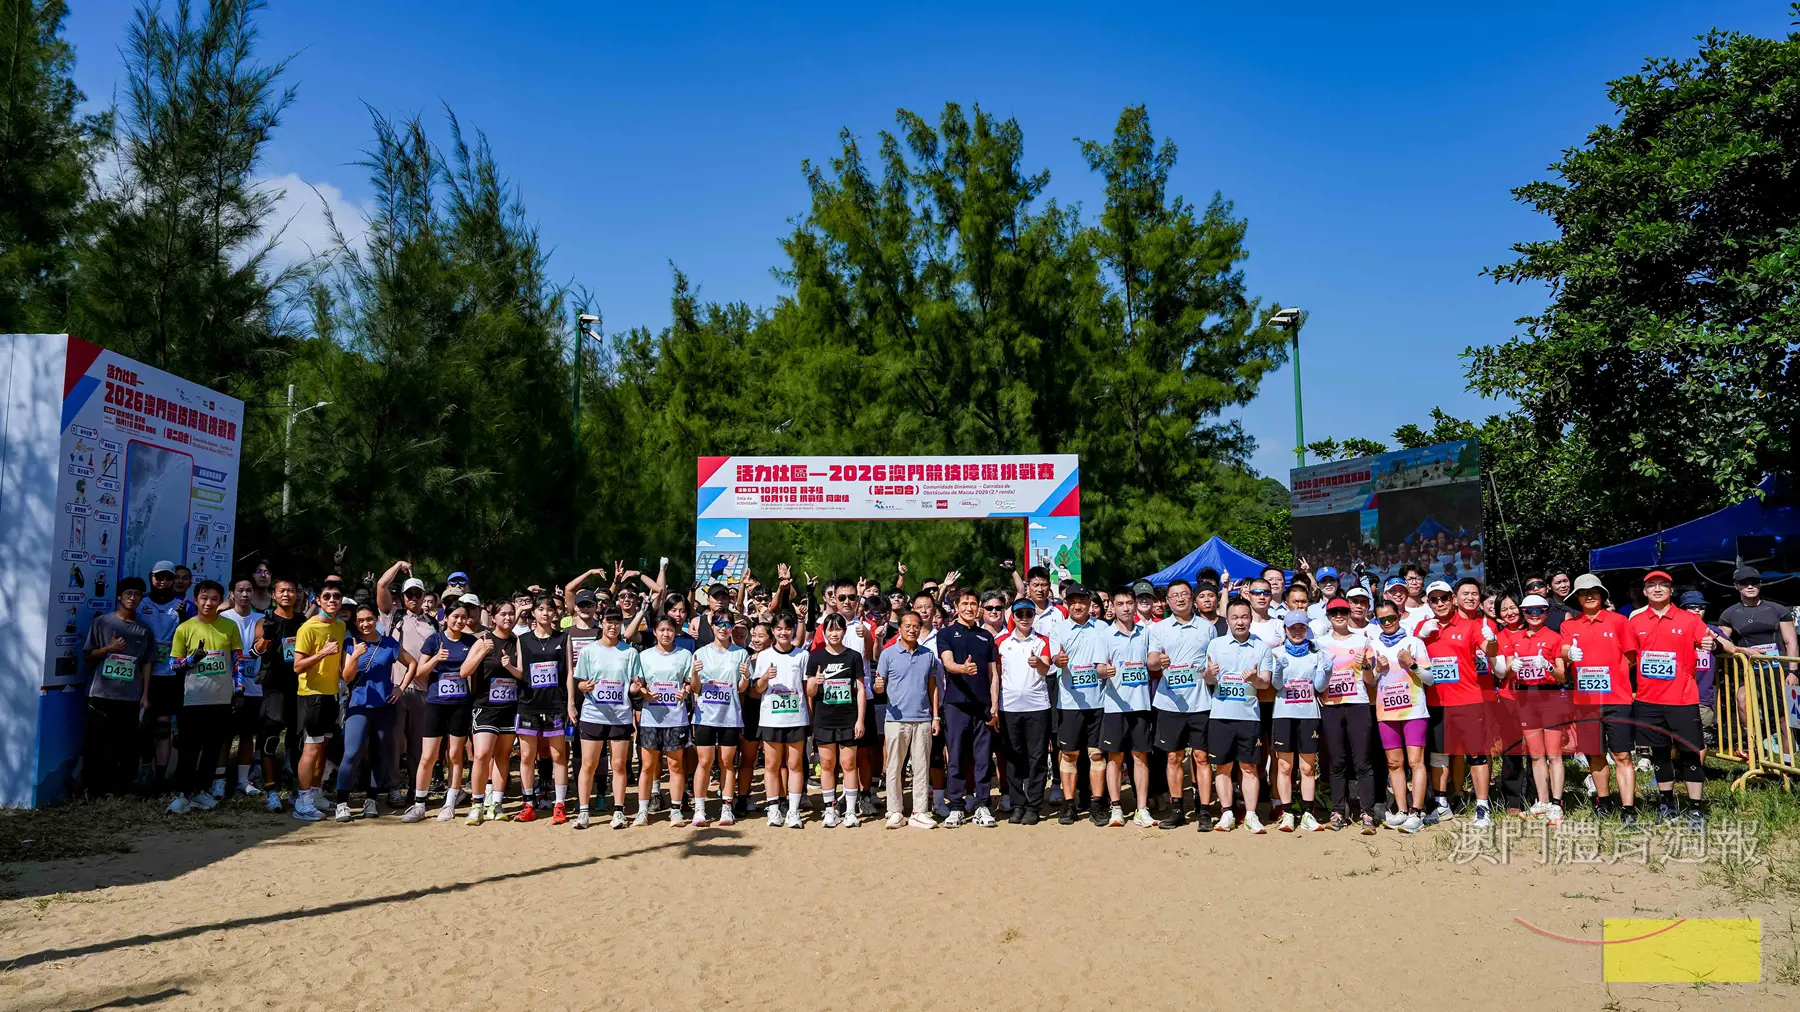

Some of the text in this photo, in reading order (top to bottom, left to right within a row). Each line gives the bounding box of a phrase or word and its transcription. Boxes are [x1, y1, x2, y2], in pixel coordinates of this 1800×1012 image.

[760, 486, 797, 494] 10月10日
[104, 664, 133, 678] D423
[197, 661, 225, 674] D430
[825, 663, 844, 672] NIKE
[1642, 664, 1674, 675] E524
[1122, 671, 1147, 682] E501
[1432, 669, 1457, 679] E521
[1518, 668, 1544, 678] E612
[532, 673, 557, 684] C311
[1071, 673, 1097, 685] E528
[1167, 673, 1194, 685] E504
[440, 684, 466, 694] C311
[1328, 682, 1355, 693] E607
[1579, 680, 1609, 690] E523
[491, 690, 516, 699] C311
[597, 690, 623, 700] C306
[704, 690, 730, 701] C306
[825, 690, 850, 700] D412
[1219, 686, 1245, 697] E503
[1286, 689, 1311, 699] E601
[657, 692, 676, 702] 306
[1383, 694, 1410, 707] E608
[772, 700, 798, 710] D413
